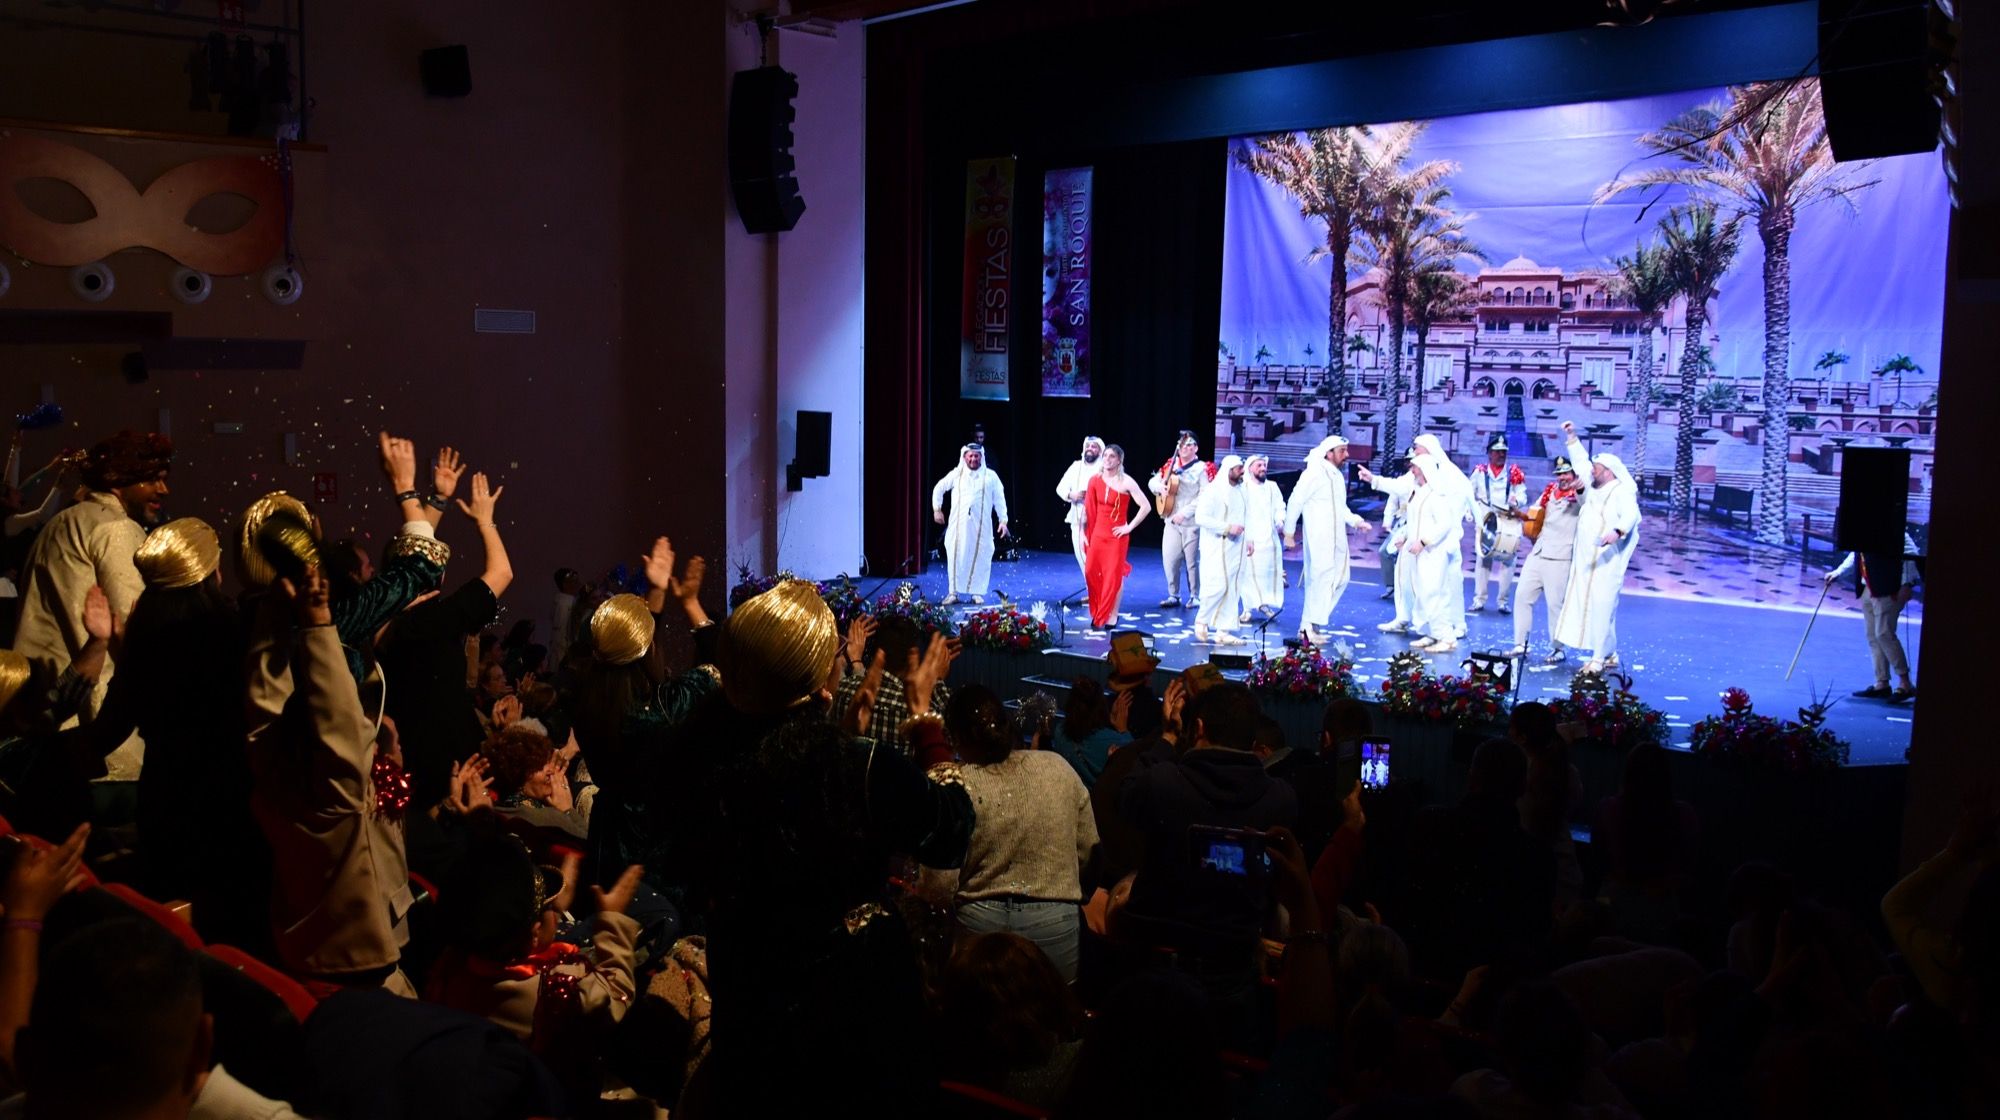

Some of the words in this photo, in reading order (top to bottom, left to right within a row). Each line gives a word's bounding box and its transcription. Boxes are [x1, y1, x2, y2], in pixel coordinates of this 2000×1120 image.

[1070, 182, 1089, 271] ROQUE
[984, 227, 1008, 352] FIESTAS
[1070, 277, 1085, 327] SAN
